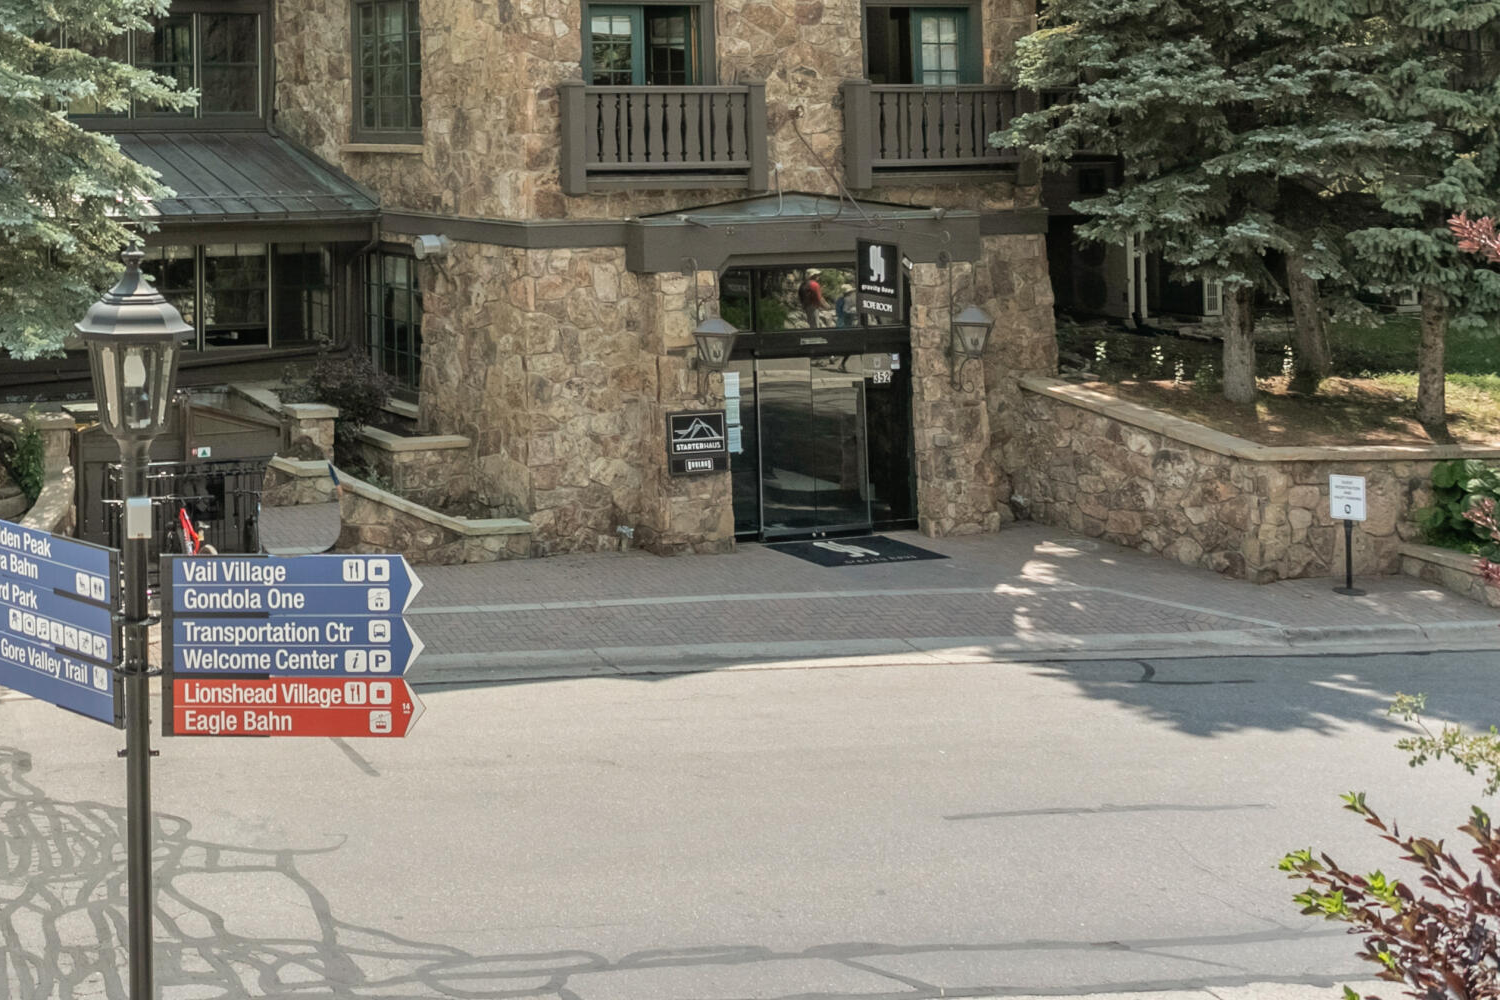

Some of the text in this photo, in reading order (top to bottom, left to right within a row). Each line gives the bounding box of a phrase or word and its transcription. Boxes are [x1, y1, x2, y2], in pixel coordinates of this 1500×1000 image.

[876, 302, 893, 313] ROOM
[874, 371, 890, 383] 352
[676, 441, 721, 451] STARTERHAUS
[23, 532, 52, 558] Peak
[10, 553, 38, 579] Bahn
[182, 561, 286, 586] Vail Village
[12, 584, 38, 610] Park
[183, 588, 305, 609] Gondola One
[182, 621, 354, 646] Transportation Ctr
[1, 638, 26, 663] Gore
[28, 646, 61, 678] Valley
[63, 658, 88, 684] Trail
[182, 649, 271, 670] Welcome
[275, 649, 338, 670] Center
[374, 654, 387, 668] P
[184, 682, 342, 709] Lionshead Village
[184, 710, 292, 735] Eagle Bahn
